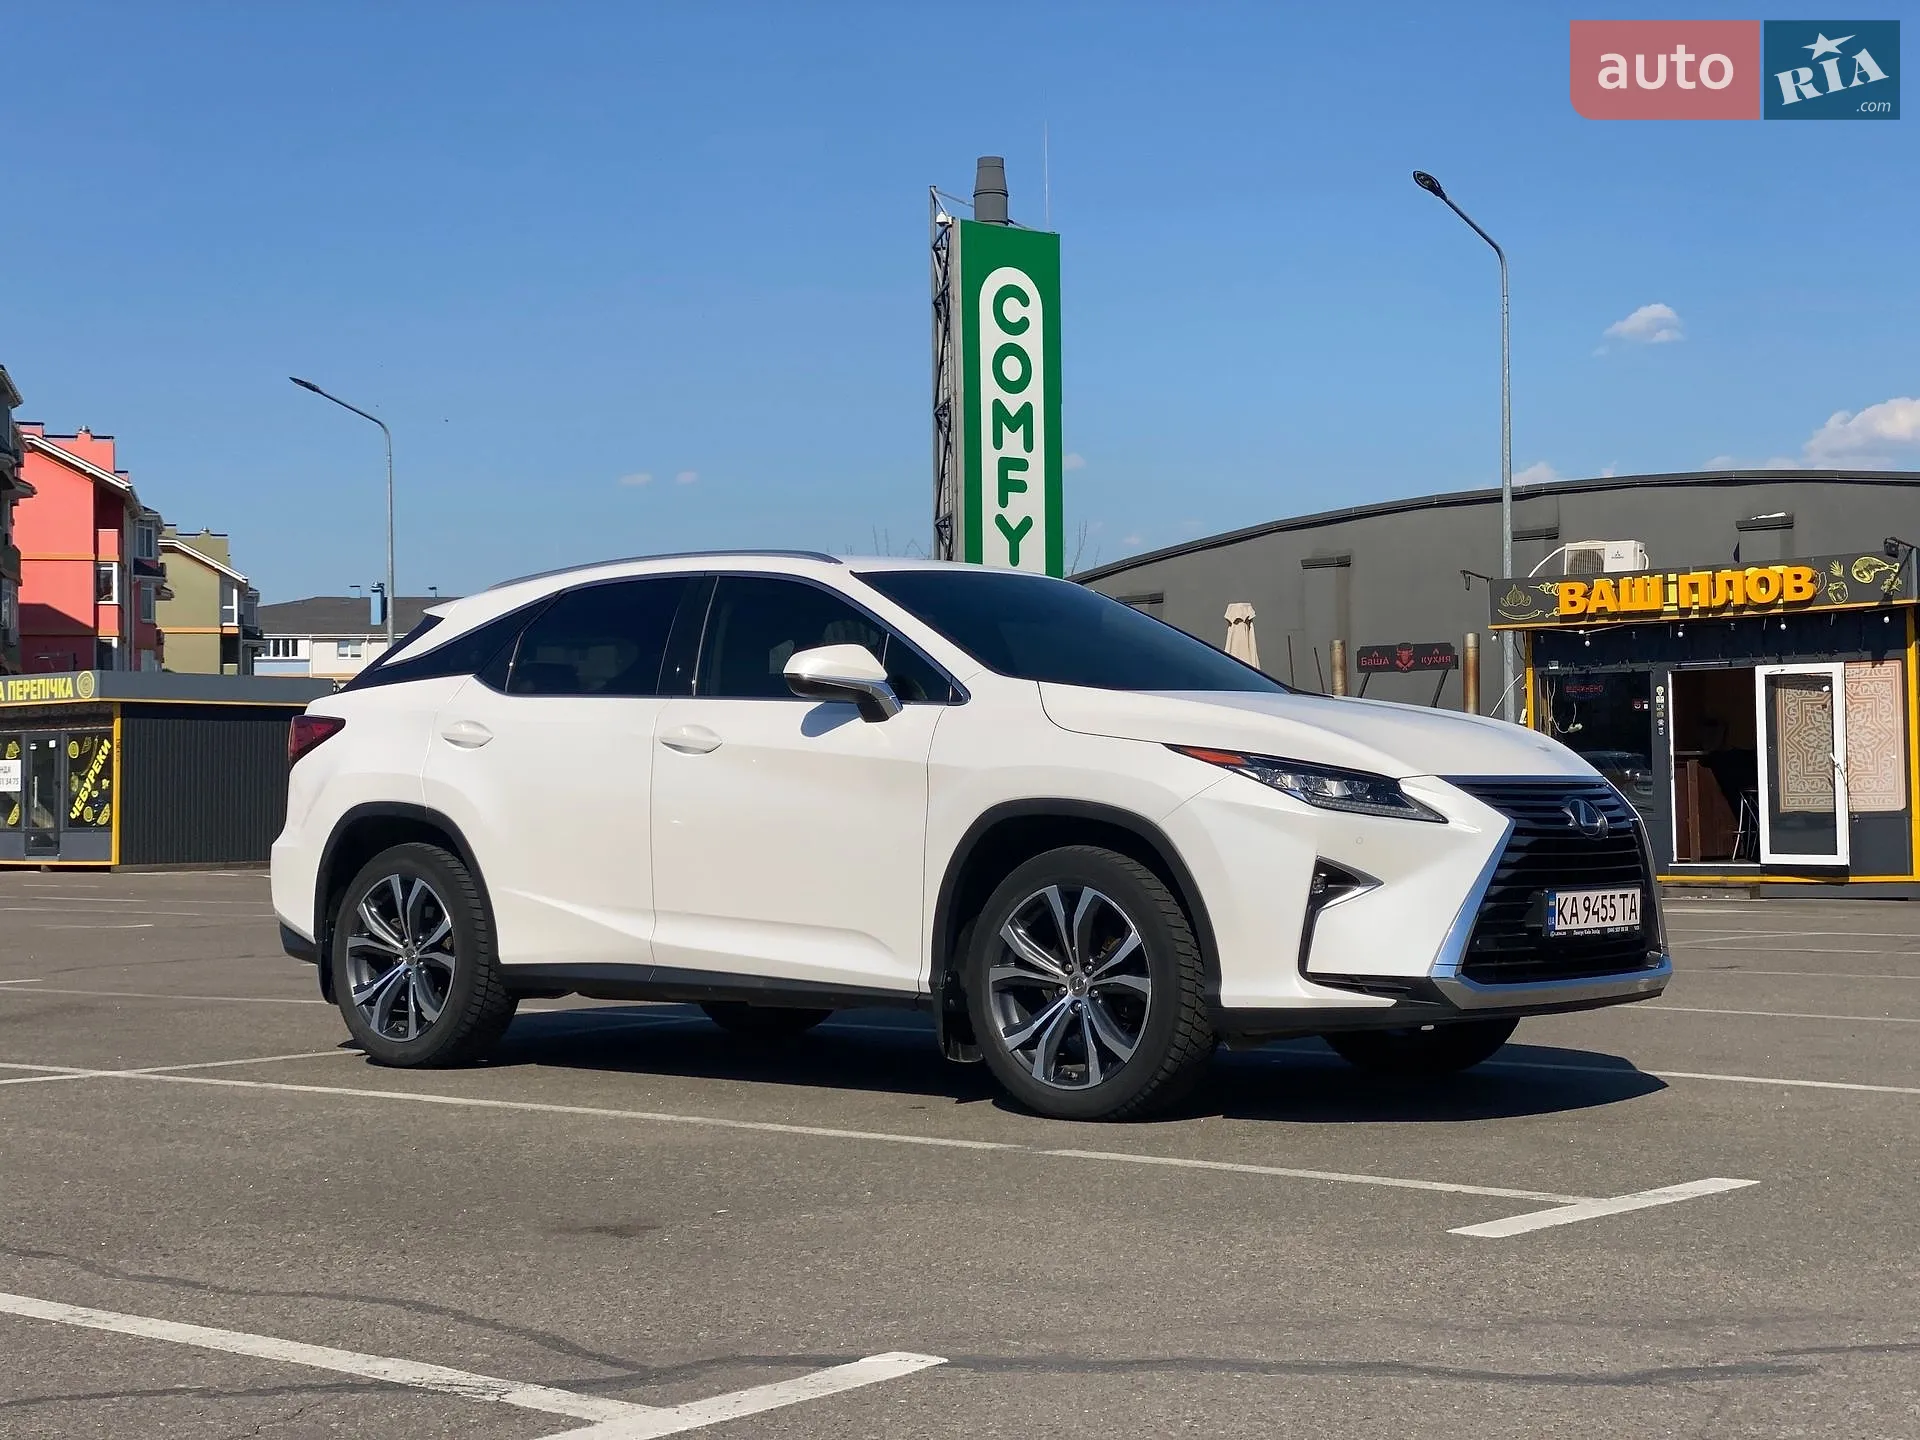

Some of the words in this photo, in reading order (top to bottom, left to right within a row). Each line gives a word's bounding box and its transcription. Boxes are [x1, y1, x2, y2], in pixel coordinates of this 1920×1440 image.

[991, 283, 1034, 567] COMFY
[1559, 575, 1664, 616] ВАШ
[1678, 566, 1817, 609] ПЛОВ
[7, 677, 74, 701] ПЕРЕПІЧКА
[69, 739, 112, 819] ЧЕБУРЕКИ
[1557, 897, 1579, 925] KA
[1583, 894, 1617, 923] 9455
[1619, 892, 1639, 921] TA
